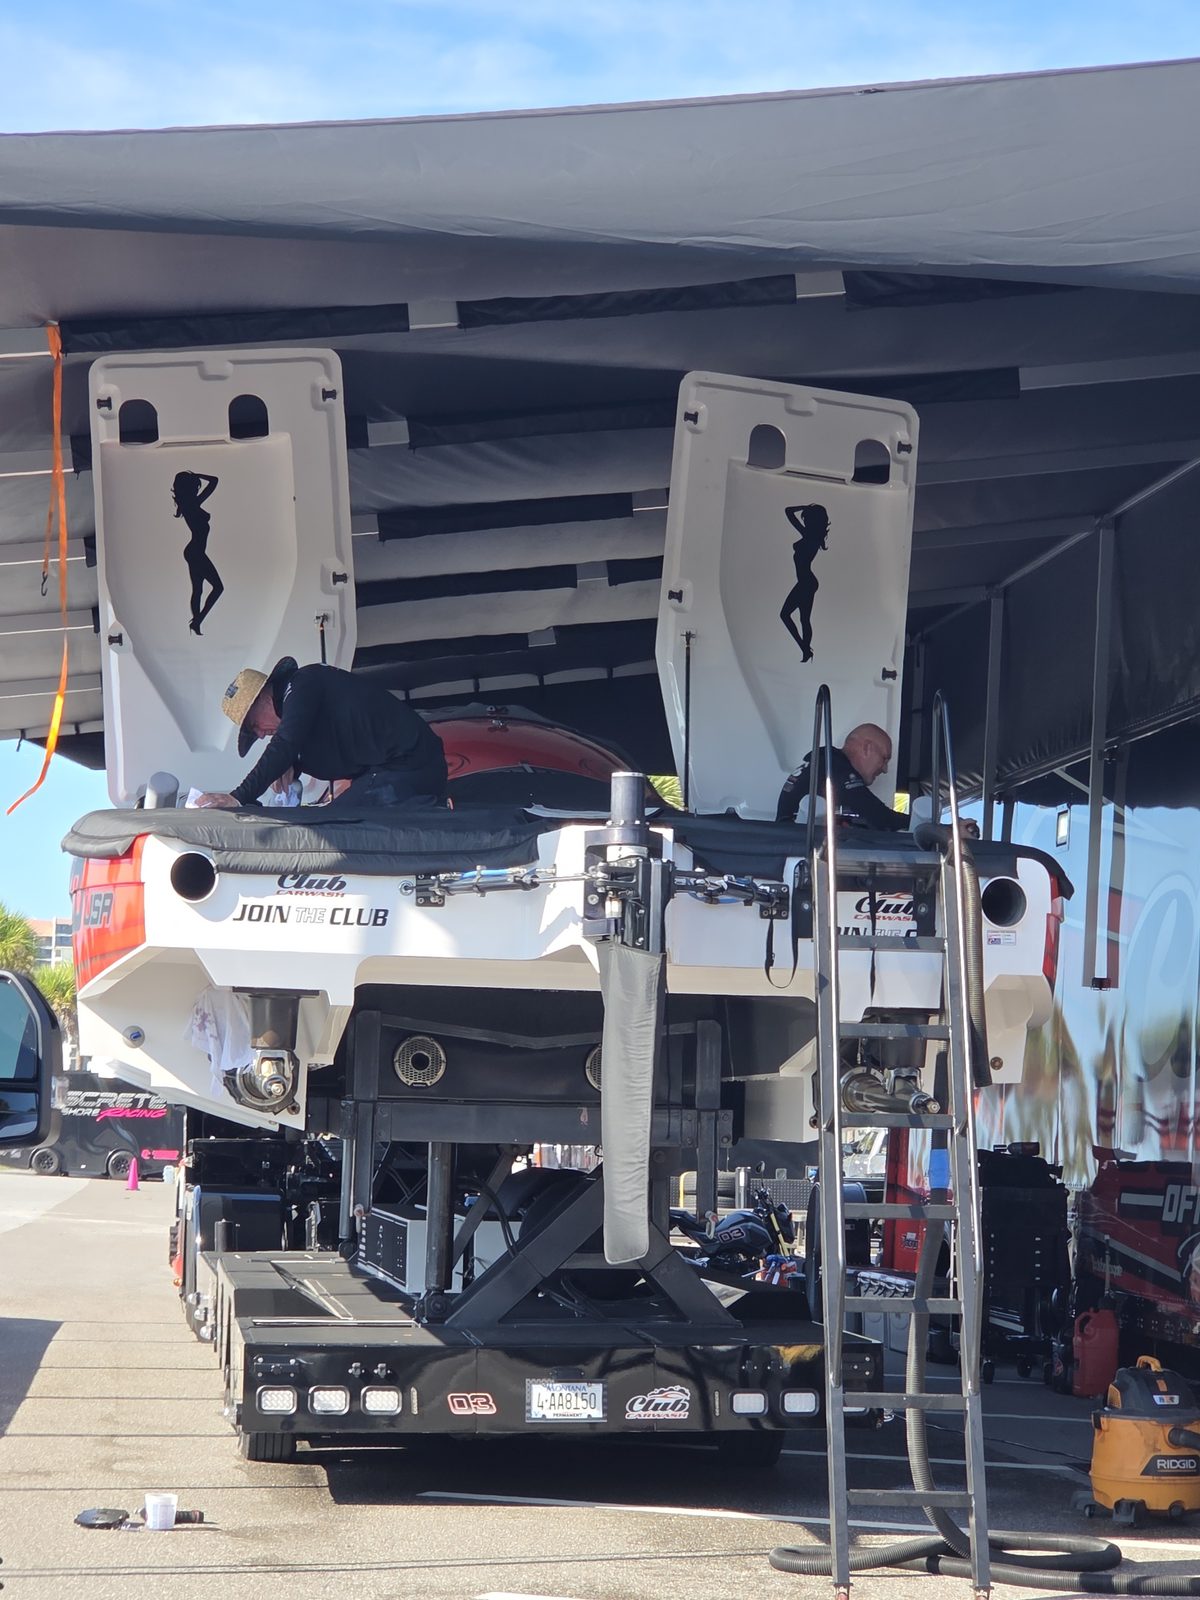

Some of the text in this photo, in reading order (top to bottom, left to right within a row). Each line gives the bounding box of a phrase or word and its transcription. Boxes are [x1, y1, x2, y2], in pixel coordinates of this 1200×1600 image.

[277, 874, 347, 891] Club
[276, 890, 345, 898] CARWASH
[232, 904, 389, 926] JOIN THE CLUB
[718, 1226, 745, 1244] 03
[447, 1392, 497, 1415] 03
[626, 1396, 689, 1413] Club
[1156, 1459, 1197, 1470] RIDGID
